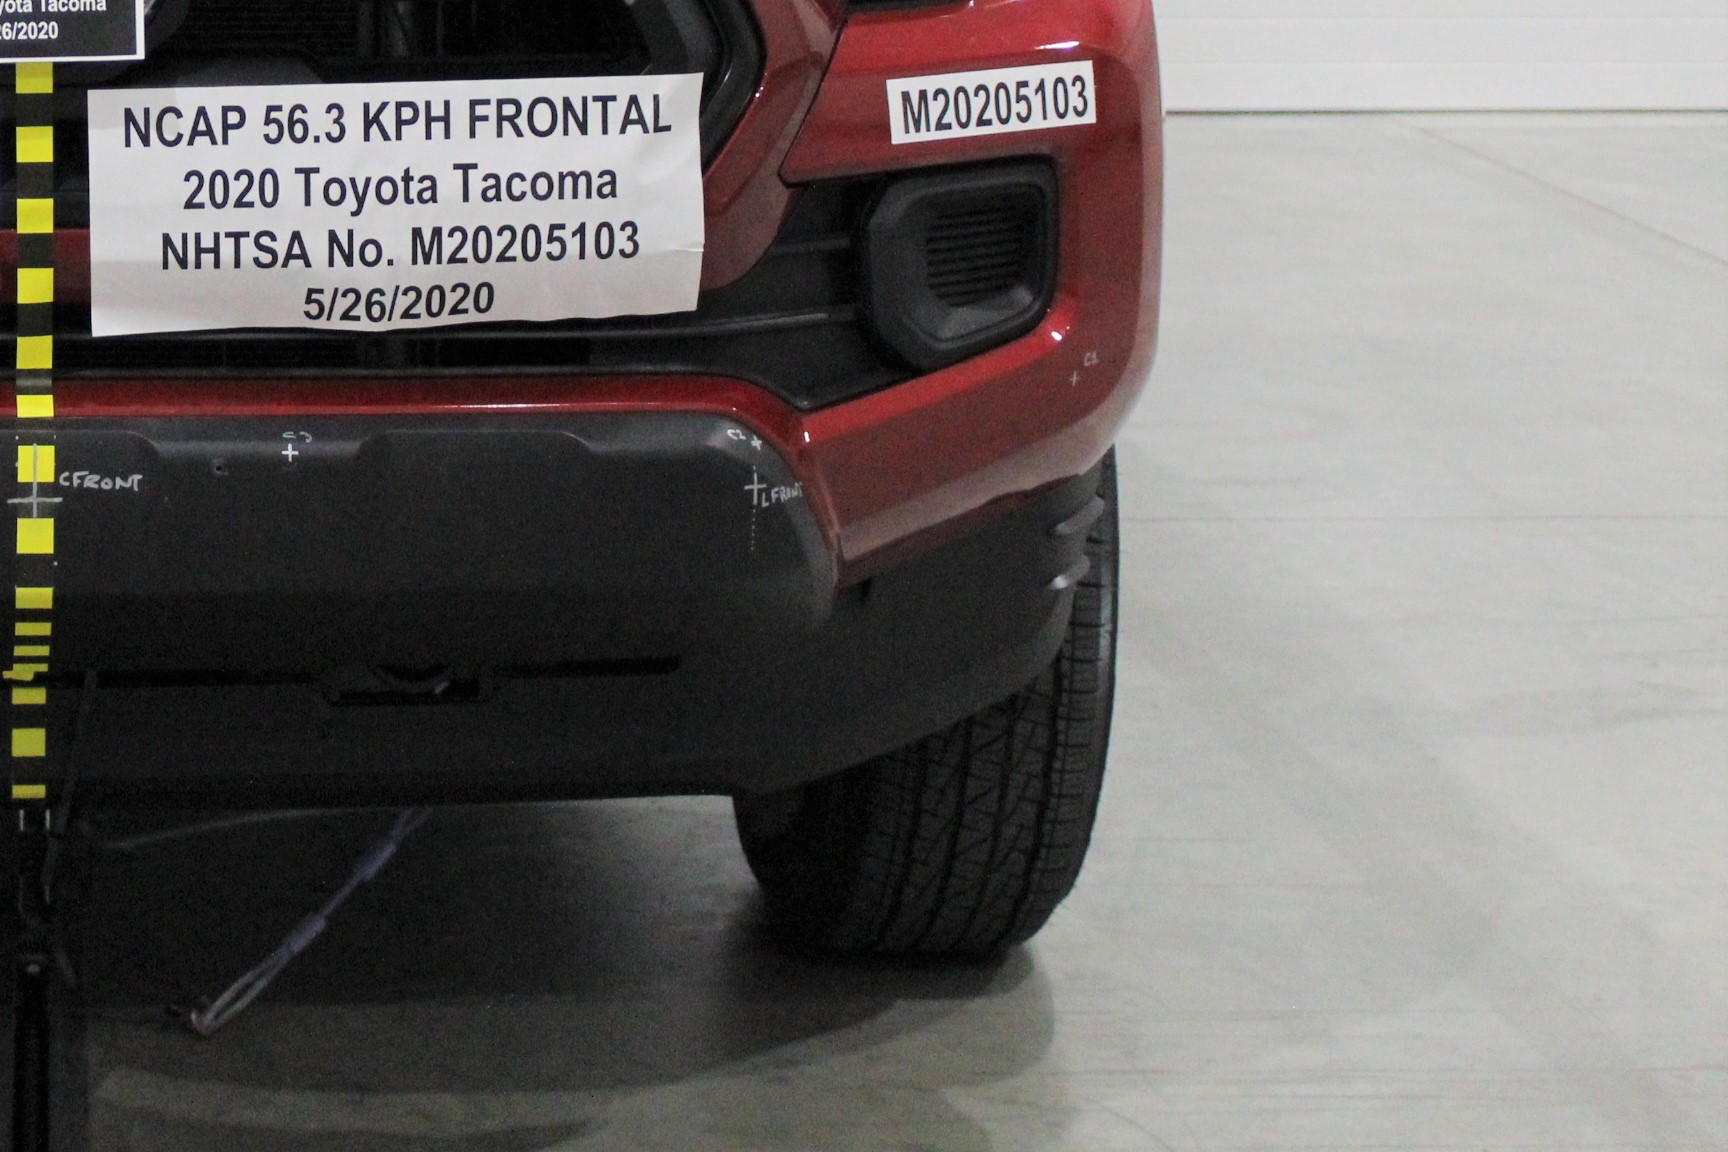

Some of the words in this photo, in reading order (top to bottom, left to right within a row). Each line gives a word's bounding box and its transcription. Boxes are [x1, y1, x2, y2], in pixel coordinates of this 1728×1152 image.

[123, 105, 247, 148] NCAP
[262, 102, 347, 145] 56.3
[363, 99, 452, 143] KPH
[468, 93, 672, 140] FRONTAL
[900, 74, 1089, 135] M20205103
[183, 168, 281, 210] 2020
[294, 166, 439, 218] Toyota
[452, 162, 619, 204] Tacoma
[161, 229, 313, 271] NHTSA
[327, 228, 395, 268] No.
[411, 220, 640, 266] M20205103
[302, 281, 496, 324] 5/26/2020
[58, 471, 143, 491] CFRONT
